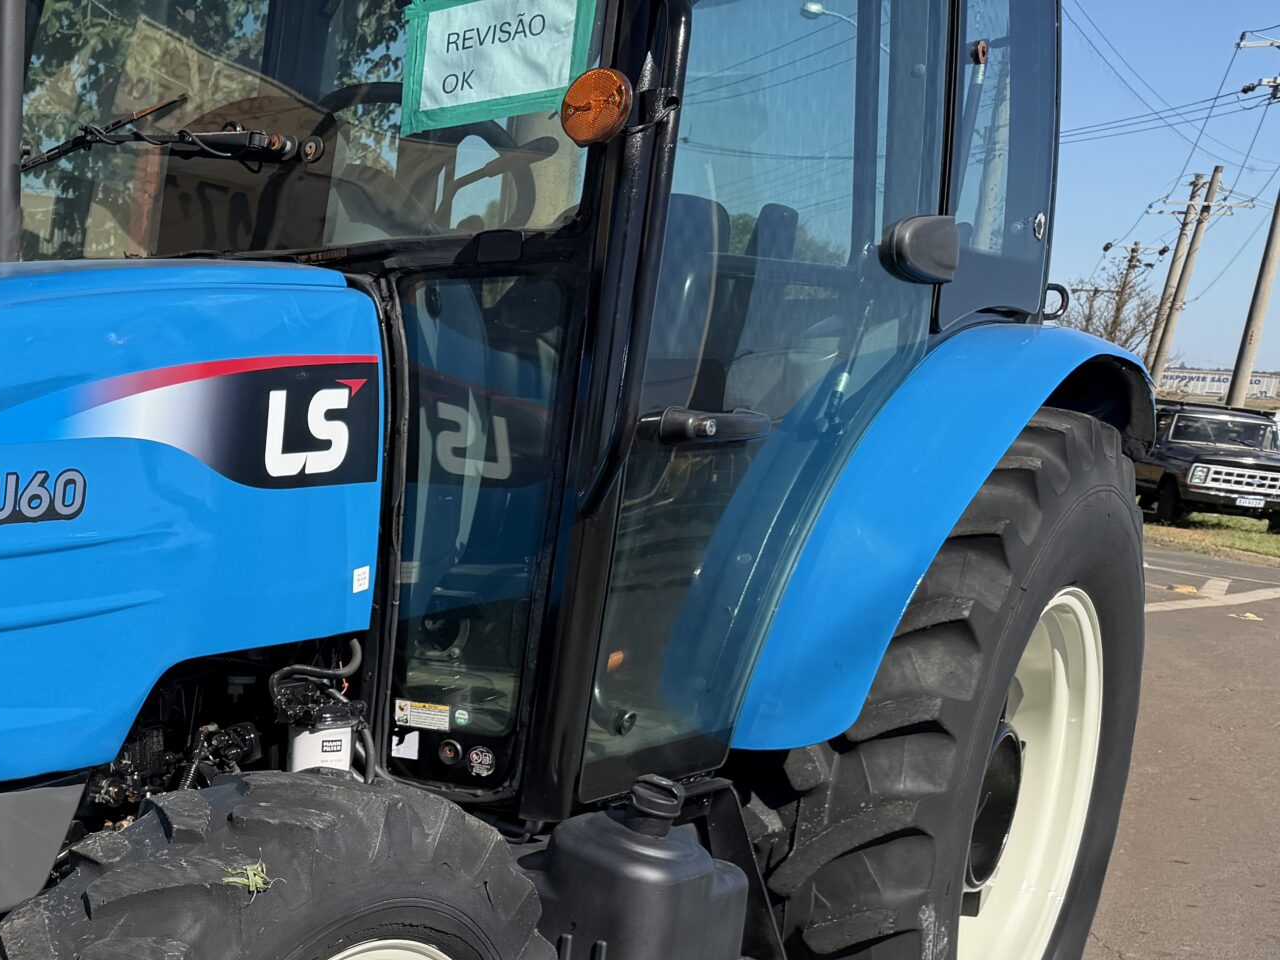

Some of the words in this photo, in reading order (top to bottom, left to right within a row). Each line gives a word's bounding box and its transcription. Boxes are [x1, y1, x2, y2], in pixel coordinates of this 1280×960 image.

[445, 12, 546, 53] REVISÃO
[441, 69, 475, 94] OK
[265, 388, 349, 477] LS
